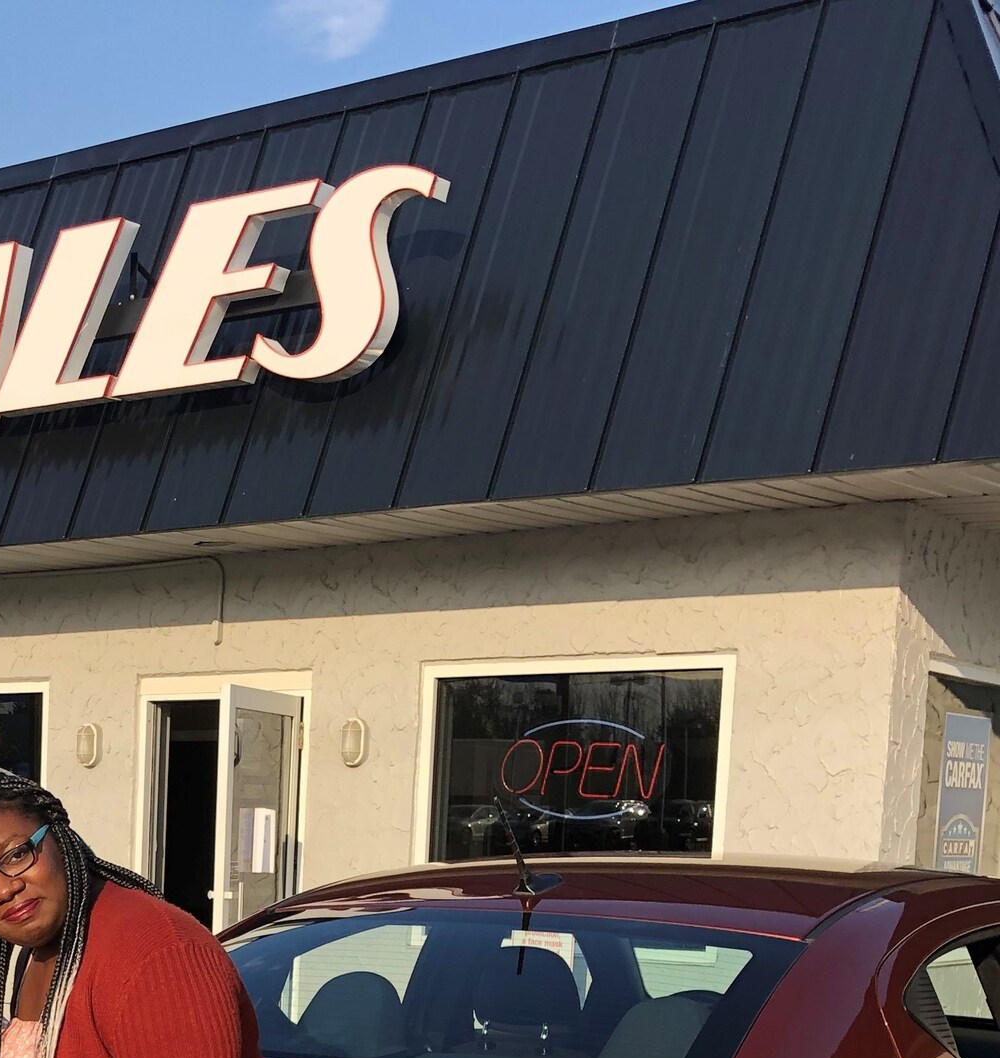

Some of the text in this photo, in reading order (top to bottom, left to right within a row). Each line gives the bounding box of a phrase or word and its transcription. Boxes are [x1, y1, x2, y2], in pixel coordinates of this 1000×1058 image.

[946, 741, 966, 759] SHOW
[500, 738, 666, 799] OPEN
[945, 760, 984, 789] CARFAX
